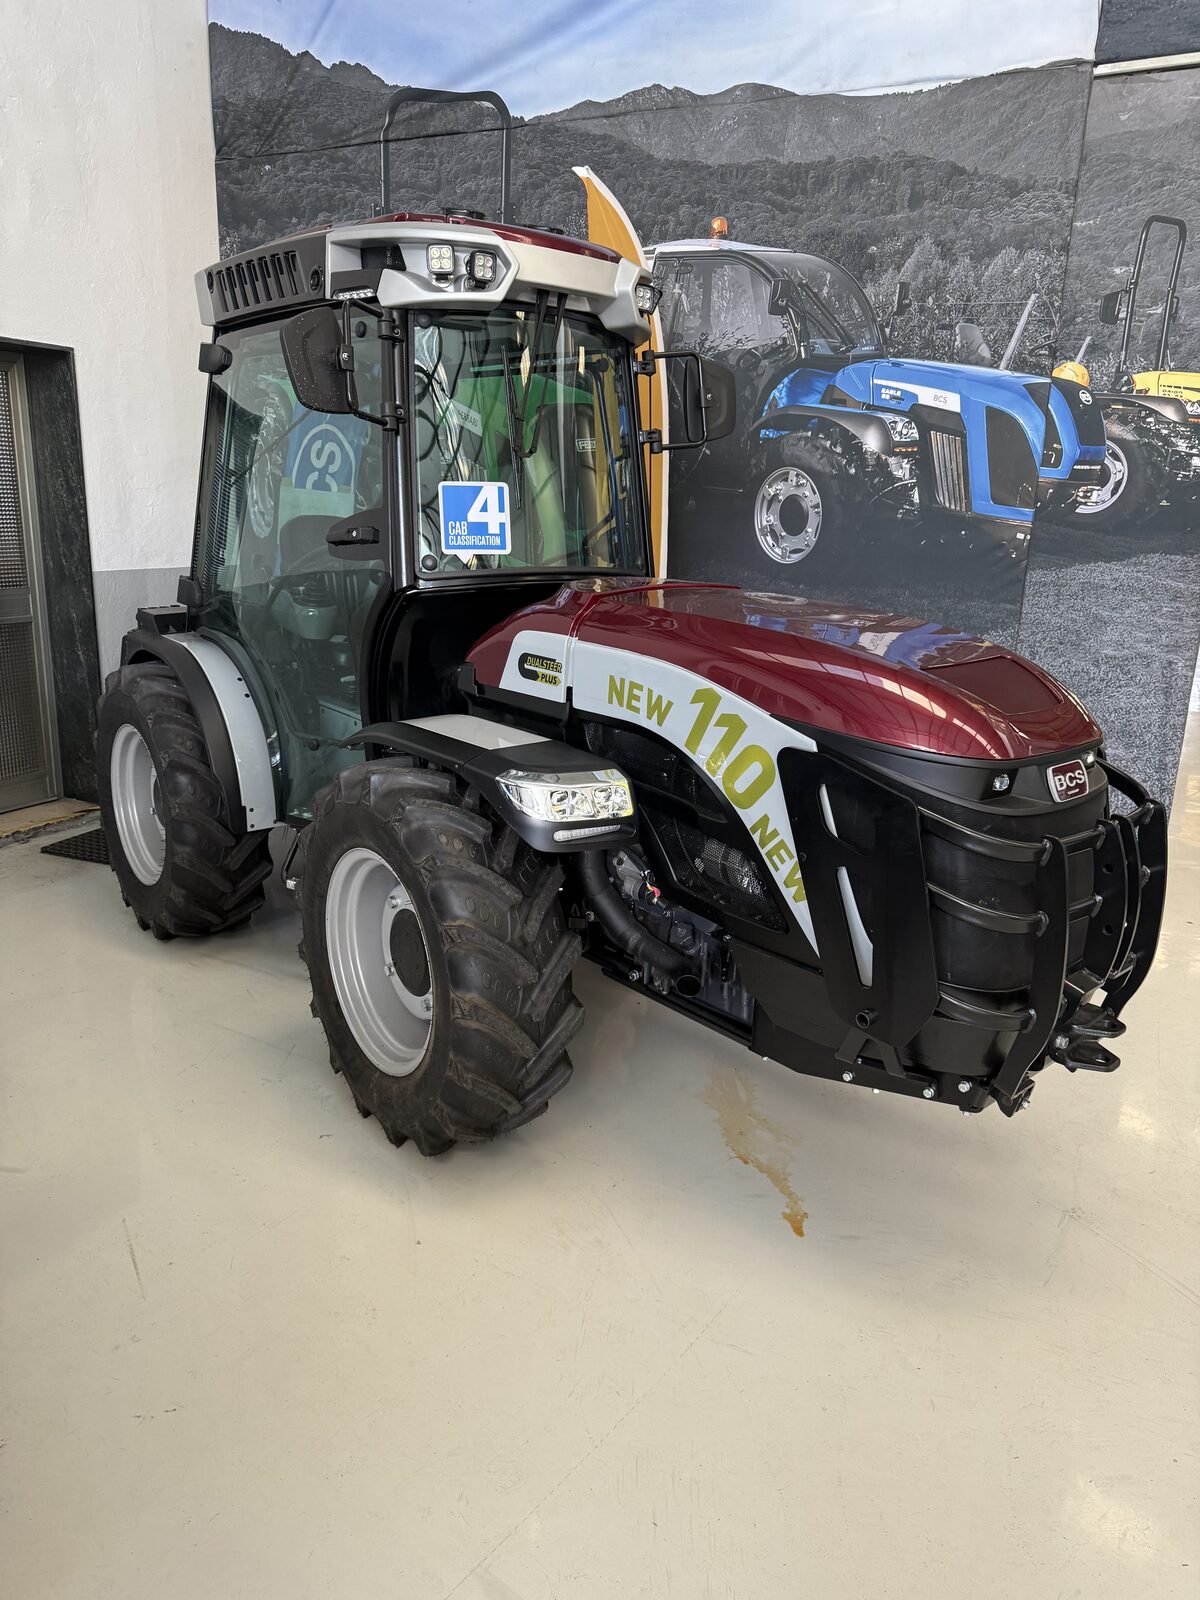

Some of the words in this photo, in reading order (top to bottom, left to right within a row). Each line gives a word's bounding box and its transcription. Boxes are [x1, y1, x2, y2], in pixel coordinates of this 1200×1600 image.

[933, 394, 948, 404] BCS
[467, 485, 506, 534] 4
[448, 521, 467, 535] CAB
[449, 535, 501, 546] CLASSIFICATION
[526, 656, 562, 673] DUALSTEER
[540, 673, 558, 685] PLUS
[1054, 769, 1085, 791] BCS
[607, 674, 674, 728] NEW
[684, 687, 776, 810] 110
[749, 813, 806, 904] NEW
